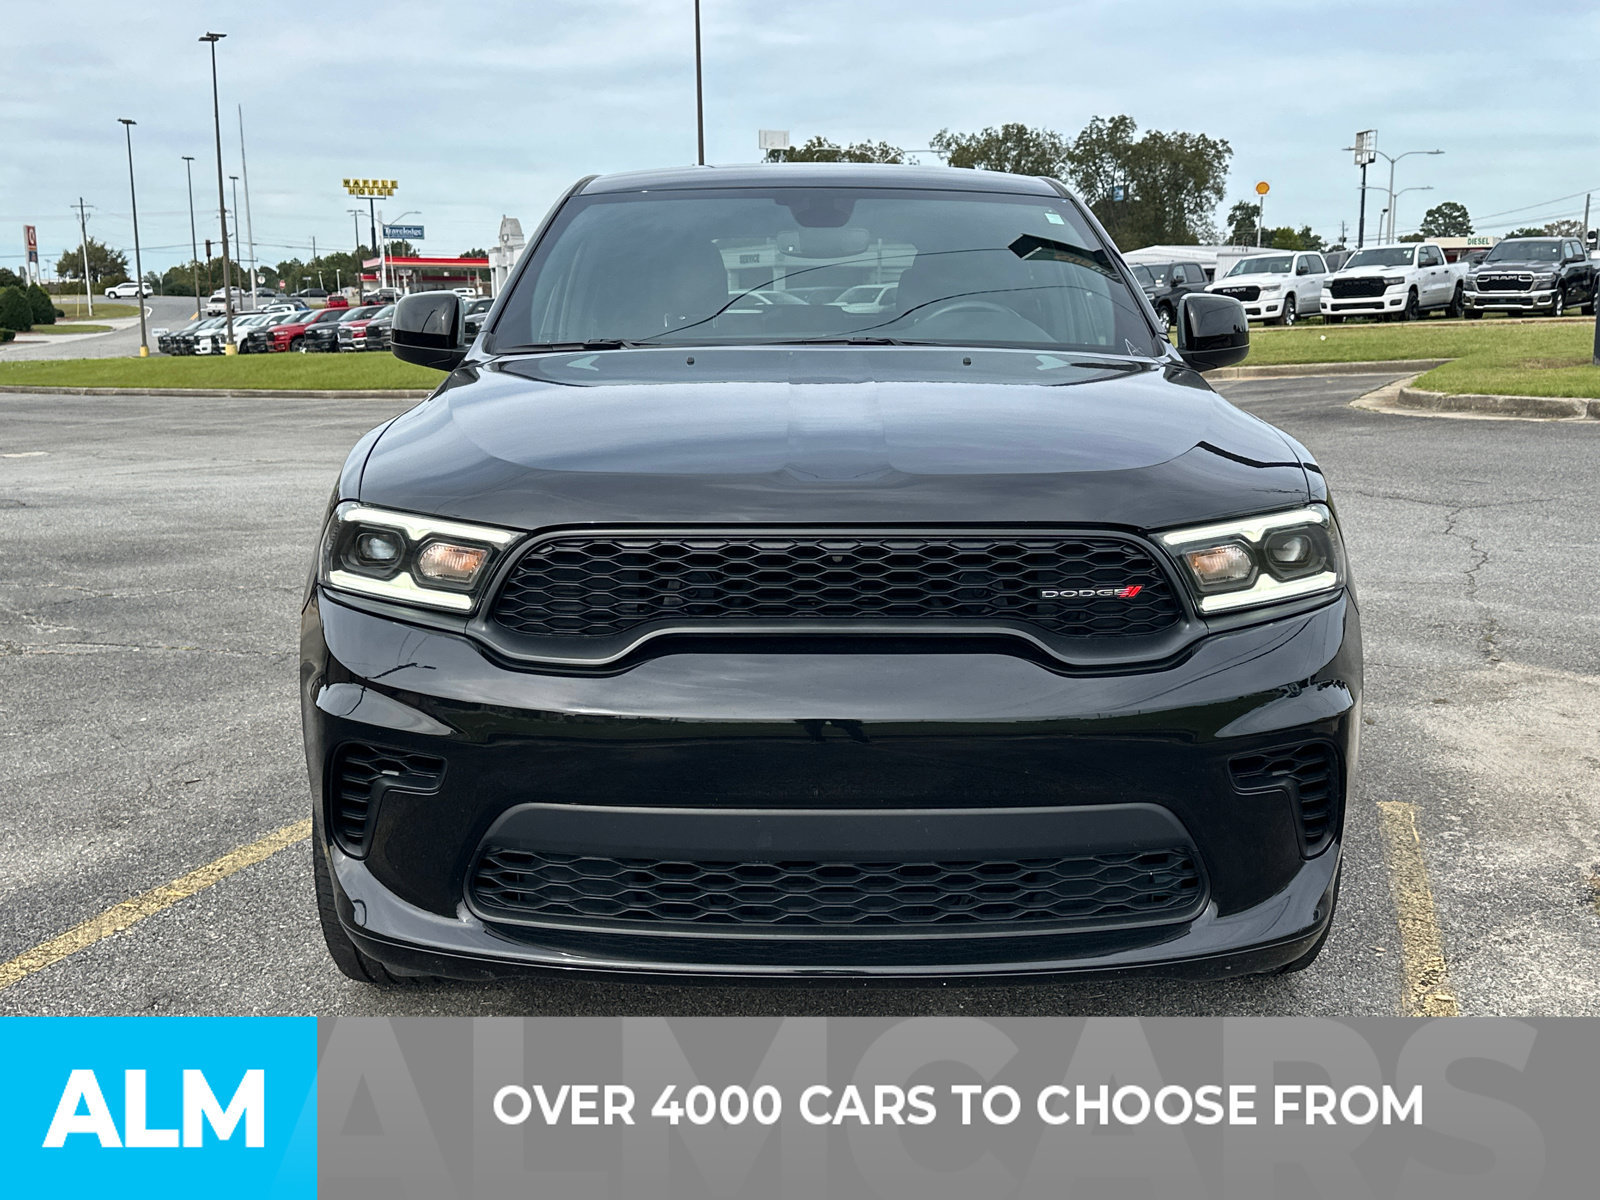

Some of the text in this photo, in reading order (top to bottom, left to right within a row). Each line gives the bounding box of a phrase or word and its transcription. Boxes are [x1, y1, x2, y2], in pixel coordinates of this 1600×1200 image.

[343, 179, 398, 187] WAFFLE
[349, 188, 394, 196] HOUSE
[1467, 237, 1490, 246] DIESEL
[1041, 588, 1131, 599] DODGE
